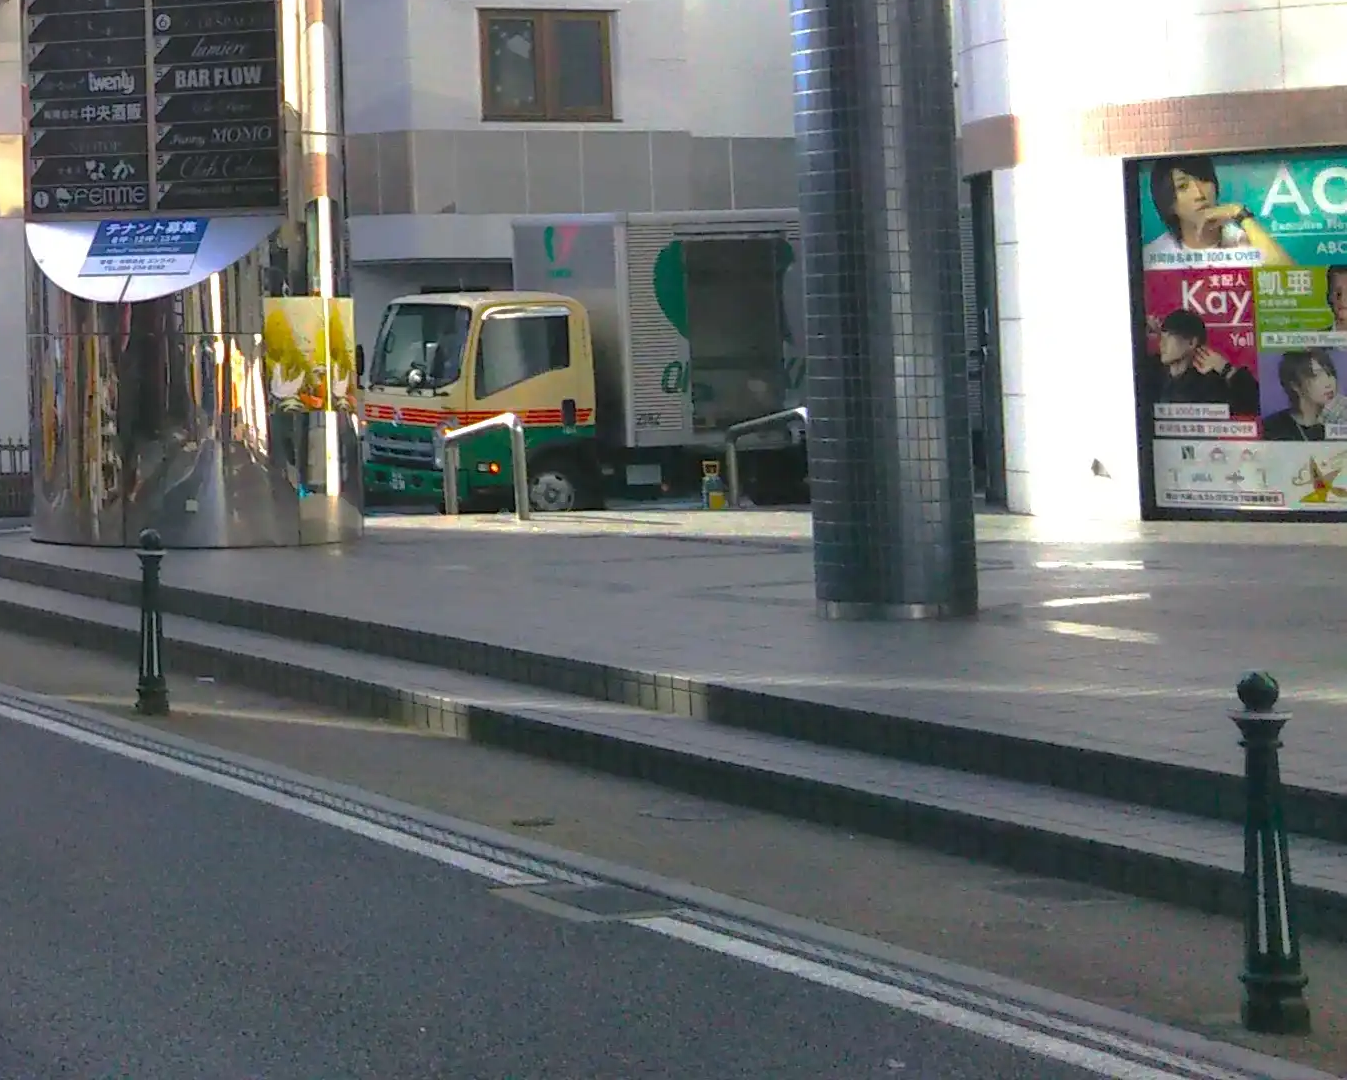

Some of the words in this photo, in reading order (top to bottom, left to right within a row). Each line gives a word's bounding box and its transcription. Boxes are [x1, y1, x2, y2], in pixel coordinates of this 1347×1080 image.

[87, 69, 135, 94] twenty
[175, 69, 210, 89] BAR
[214, 65, 263, 87] FLOW
[211, 126, 272, 144] MOMO
[105, 221, 197, 236] テナント募集
[1181, 280, 1251, 325] Kay
